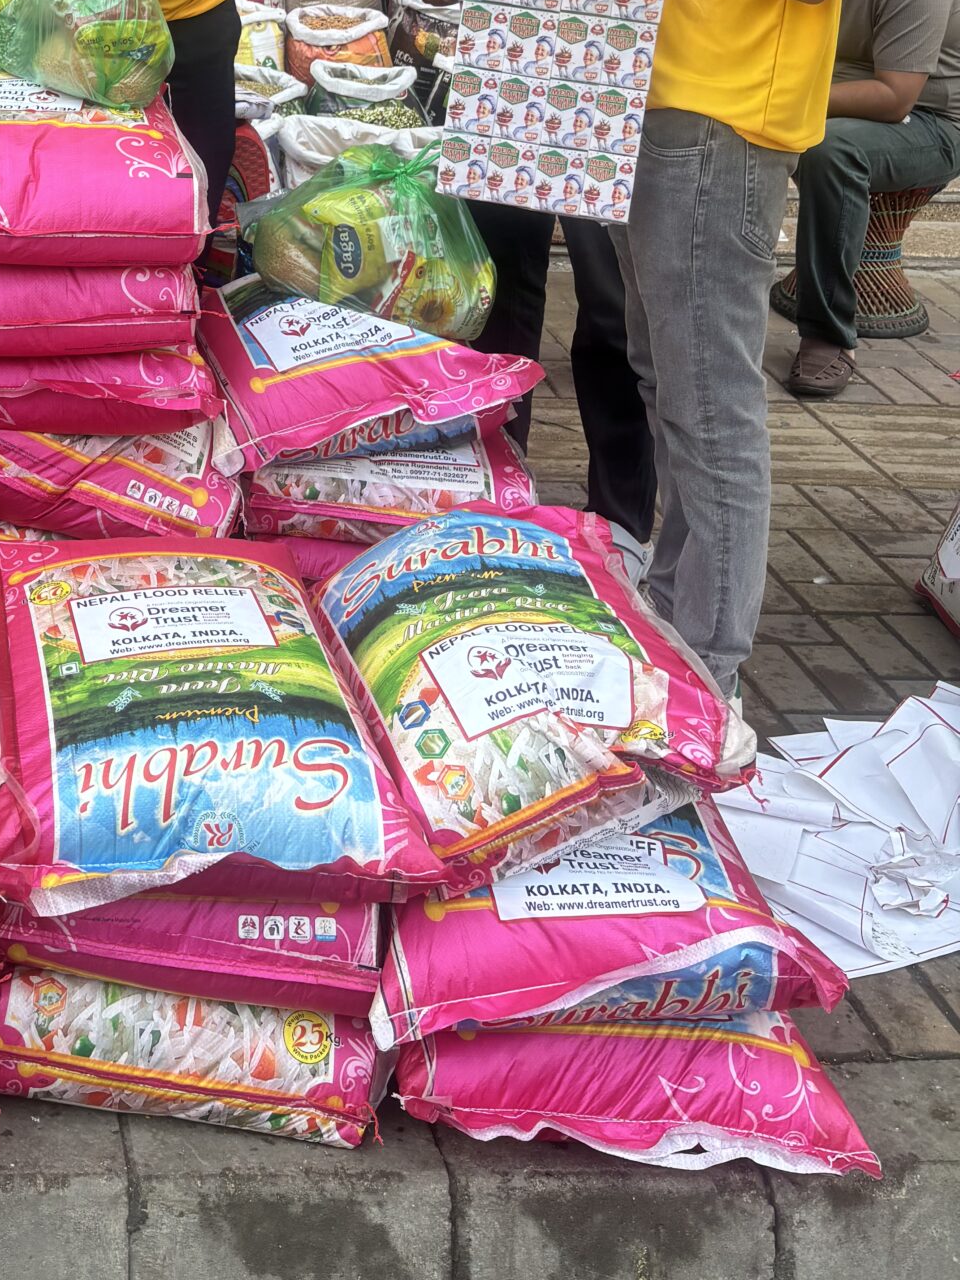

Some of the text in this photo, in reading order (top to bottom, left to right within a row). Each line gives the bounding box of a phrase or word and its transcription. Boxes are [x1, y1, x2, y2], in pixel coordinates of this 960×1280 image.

[250, 306, 289, 326] NEPAL
[290, 331, 346, 354] KOLKATA,
[293, 352, 314, 362] Web:
[341, 526, 560, 620] Surabhi
[76, 588, 248, 609] NEPAL FLOOD RELIEF
[147, 605, 227, 616] Dreamer
[150, 614, 200, 625] Trust
[109, 637, 250, 655] Web: www.dreamertrust.org
[111, 629, 243, 647] KOLKATA, INDIA.
[428, 630, 482, 659] NEPAL
[484, 624, 543, 634] FLOOD
[504, 642, 588, 658] Dreamer
[155, 704, 260, 723] Premium
[488, 704, 515, 721] Web:
[78, 737, 350, 831] Surabhi
[563, 858, 619, 870] Trust
[525, 882, 670, 897] KOLKATA, INDIA.
[525, 898, 680, 912] Web: www.dreamertrust.org
[480, 970, 754, 1028] urabhi
[286, 1013, 305, 1028] Weight
[292, 1023, 344, 1047] 25 Kg.
[293, 1045, 328, 1061] When Packed
